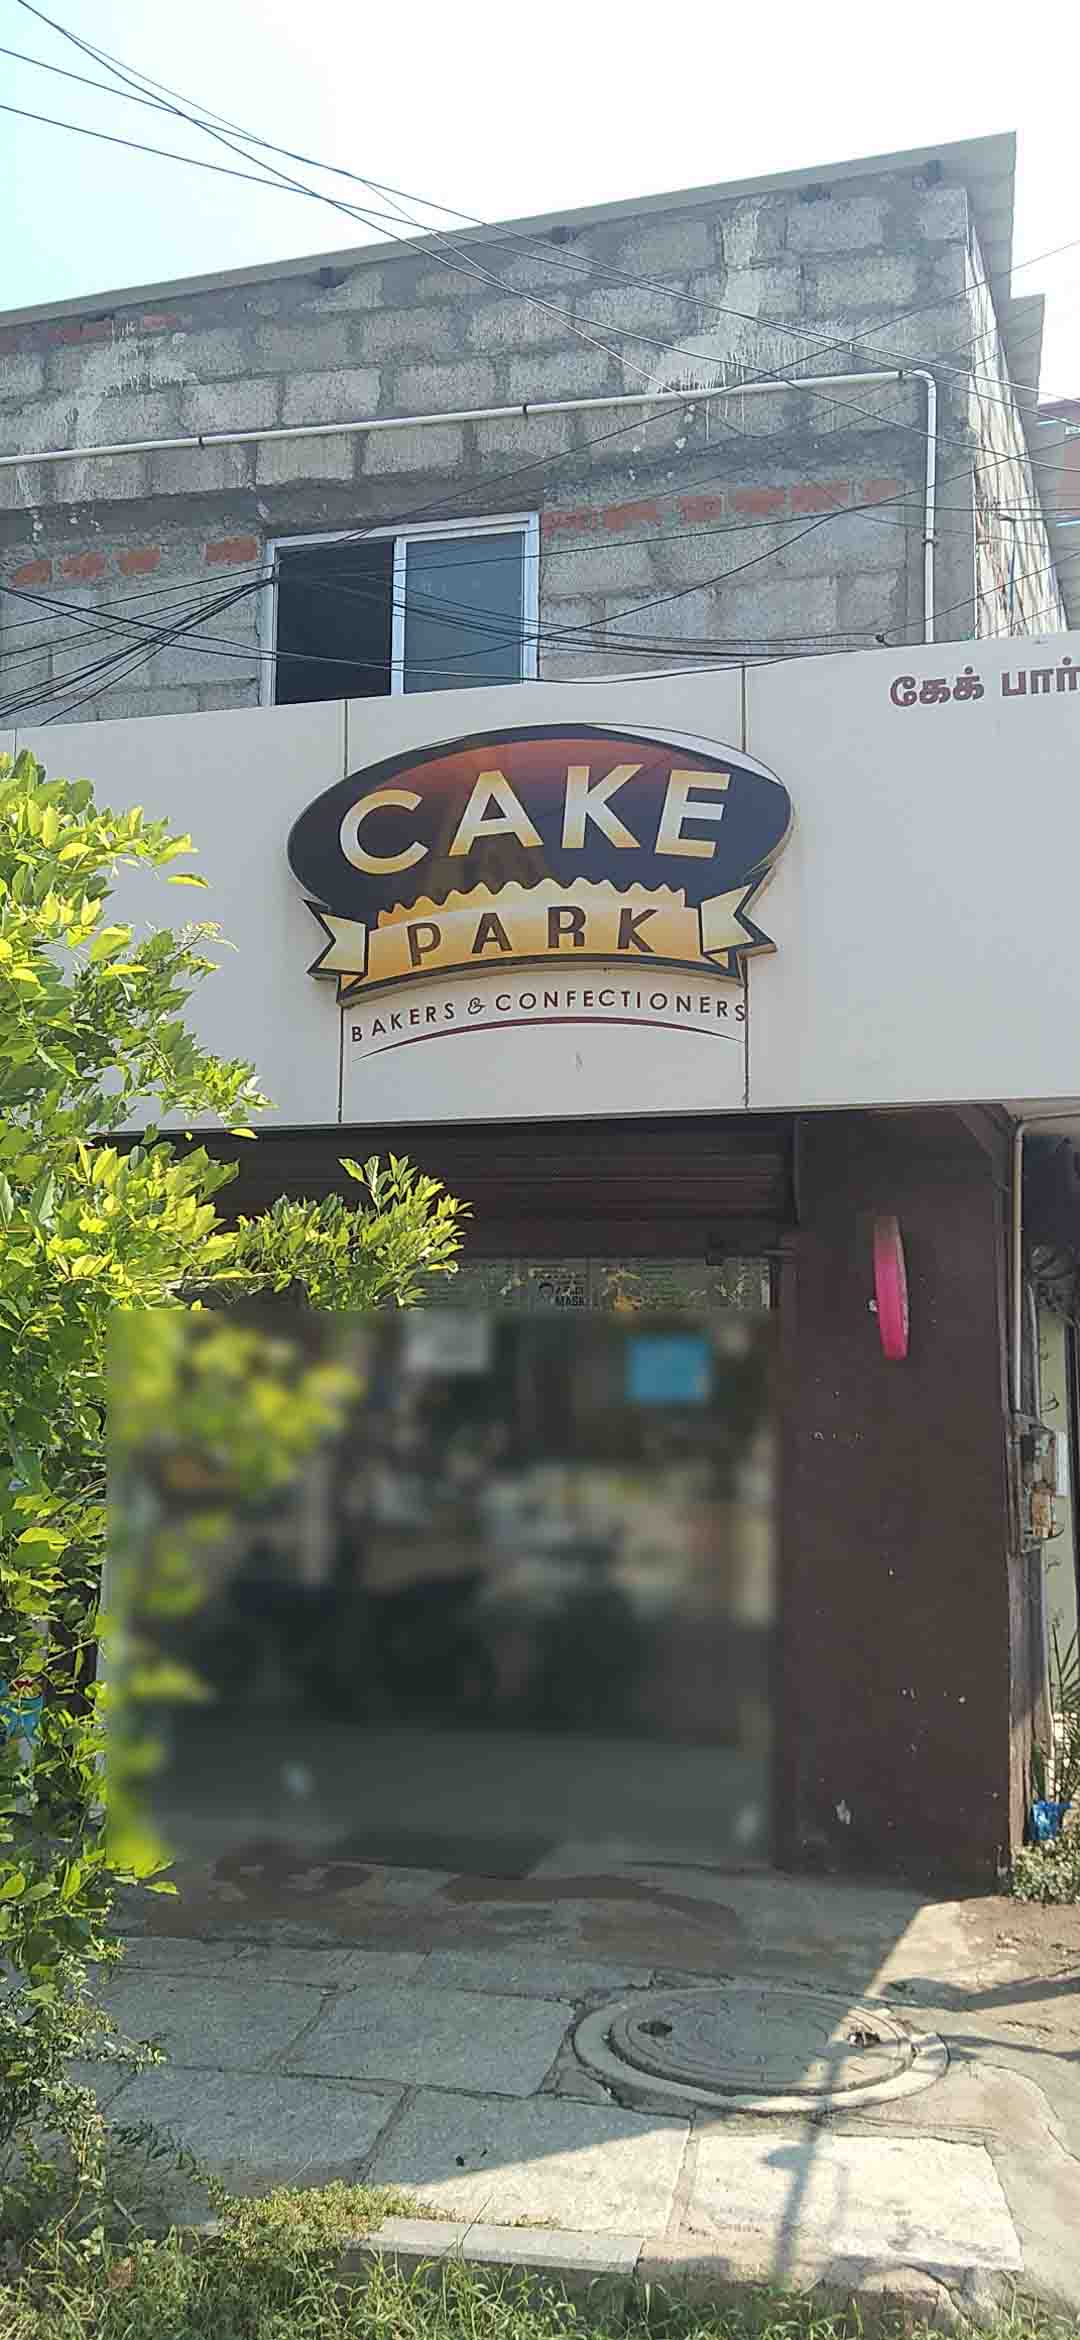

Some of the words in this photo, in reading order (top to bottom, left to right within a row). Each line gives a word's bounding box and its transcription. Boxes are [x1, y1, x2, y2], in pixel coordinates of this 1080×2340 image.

[890, 666, 985, 707] கேக்
[339, 764, 730, 875] CAKE
[406, 905, 660, 967] PARK
[351, 1002, 455, 1042] BAKERS
[467, 997, 486, 1015] &
[495, 989, 746, 1022] CONFECTIONERS
